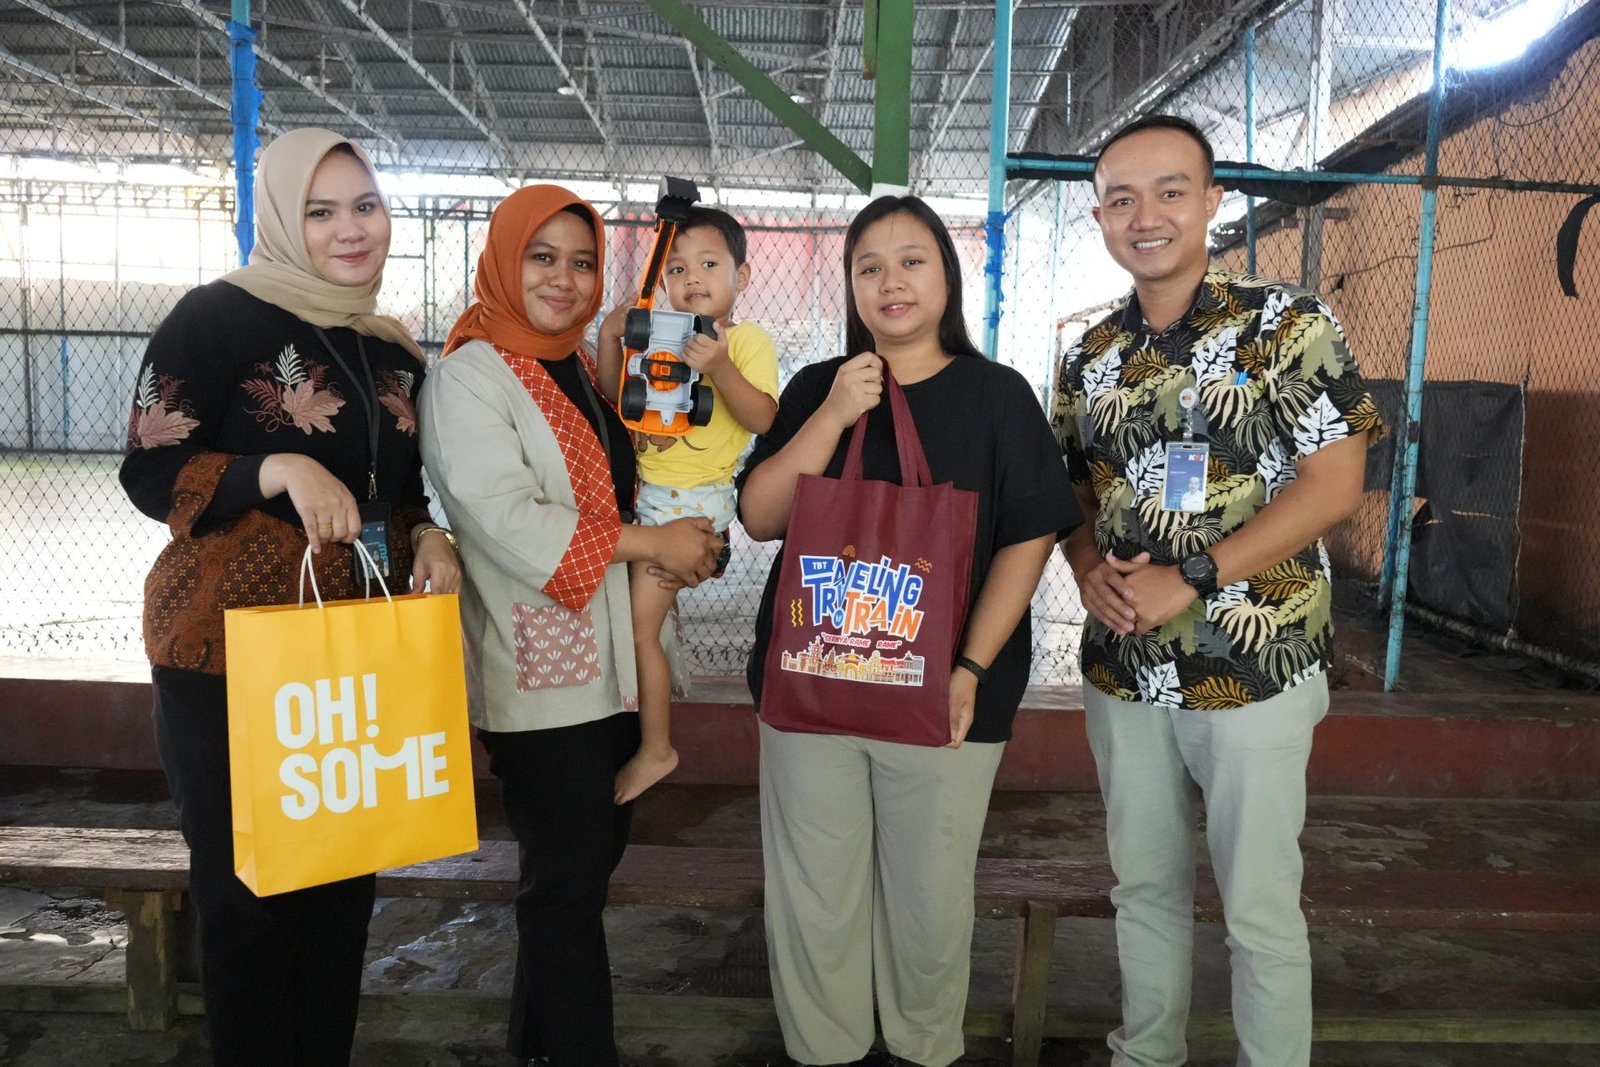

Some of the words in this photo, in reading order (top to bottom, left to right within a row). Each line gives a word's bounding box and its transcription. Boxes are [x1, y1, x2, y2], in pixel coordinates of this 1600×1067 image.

[812, 561, 827, 570] TBT
[274, 673, 379, 749] OH!
[279, 731, 449, 820] SOME
